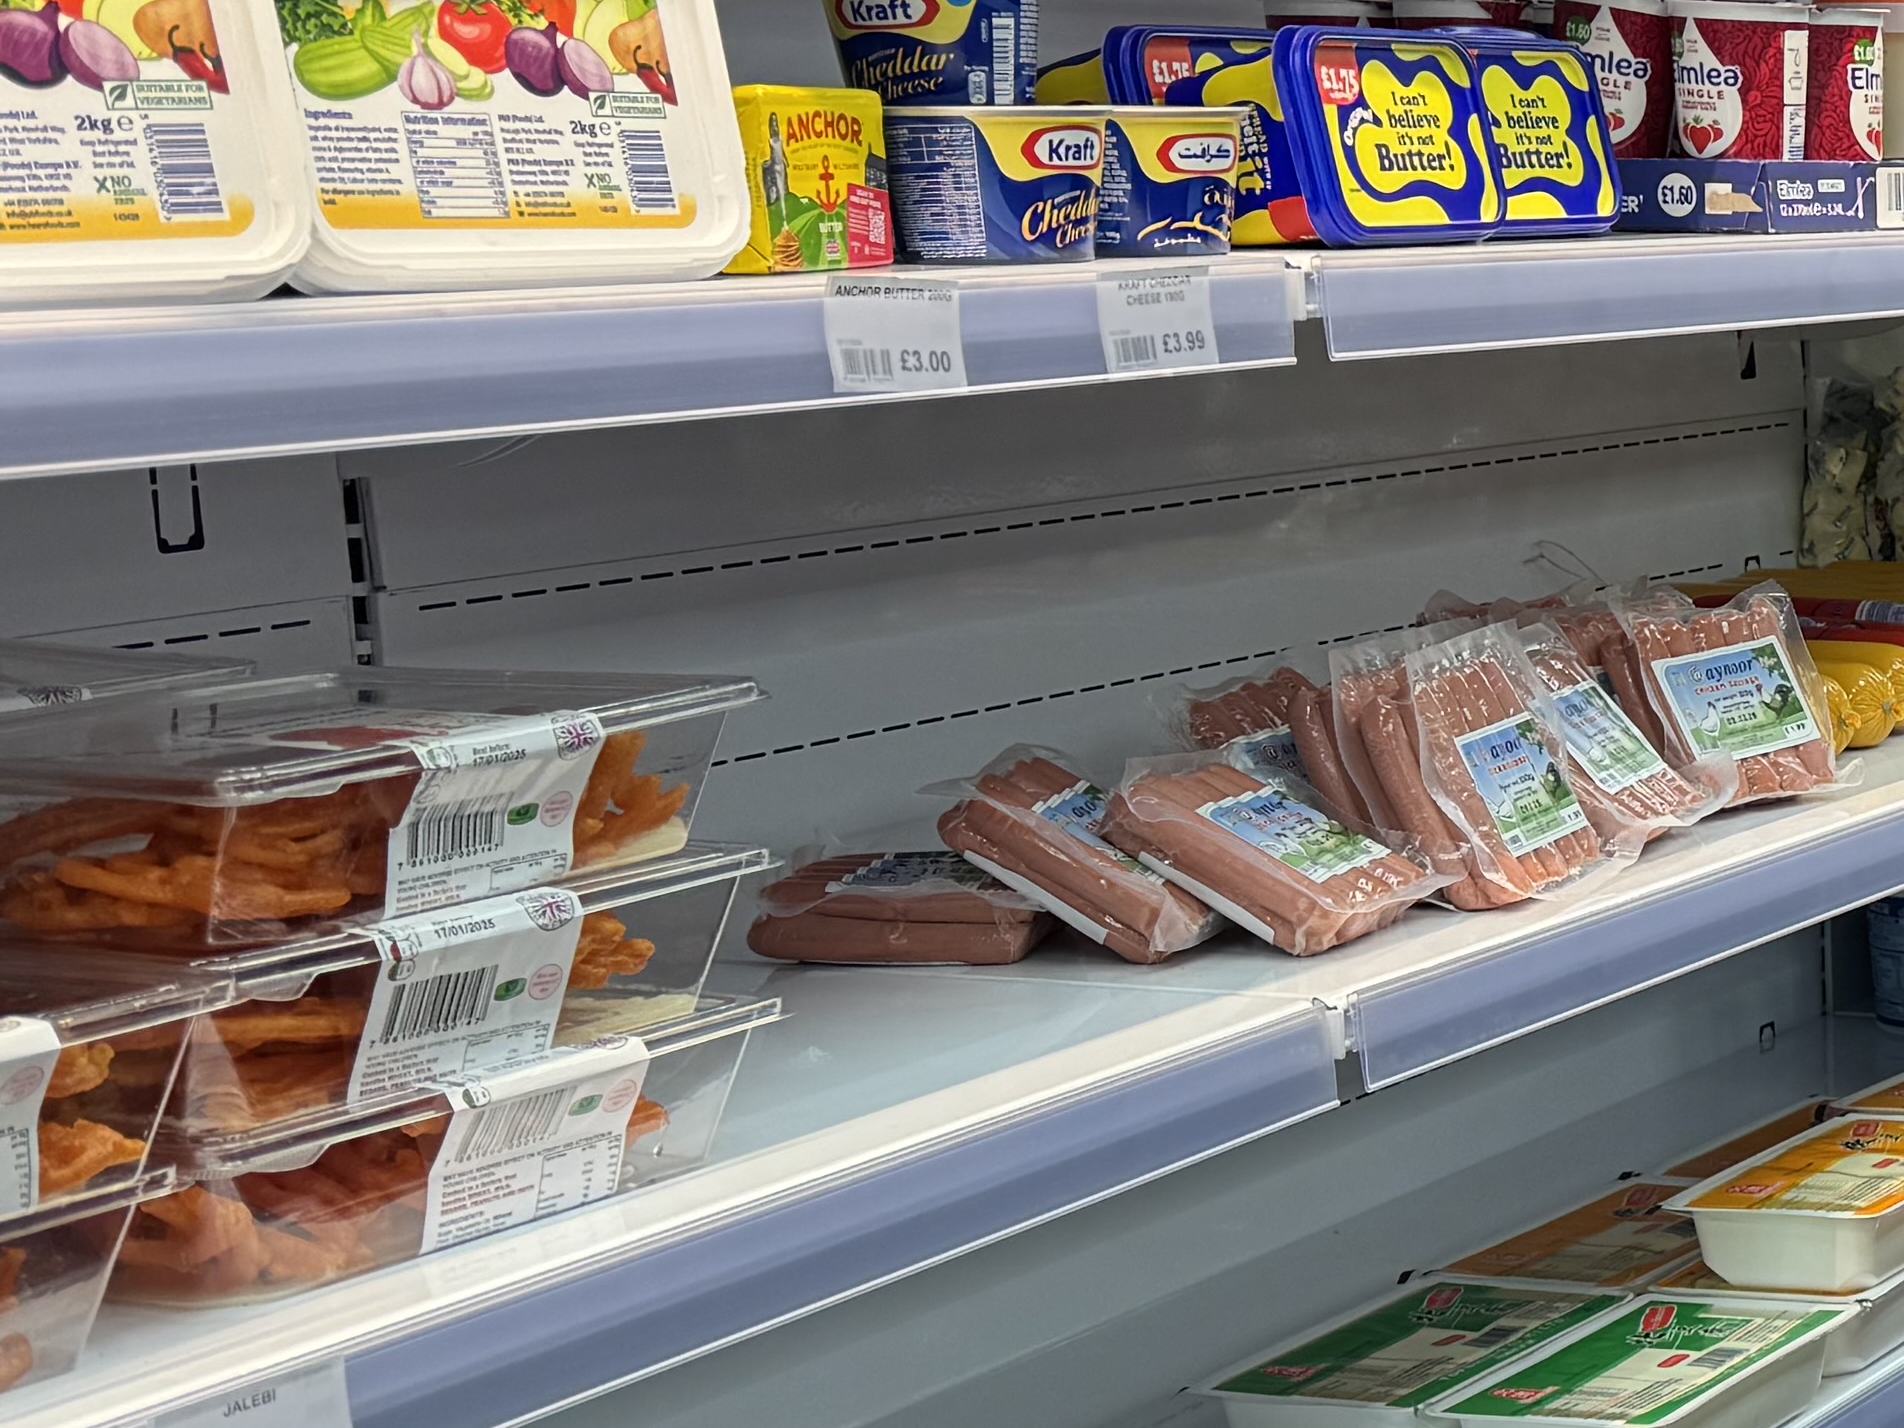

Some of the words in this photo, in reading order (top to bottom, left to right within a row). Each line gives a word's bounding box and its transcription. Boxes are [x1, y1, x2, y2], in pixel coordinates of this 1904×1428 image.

[851, 44, 954, 90] Cheddar
[1321, 65, 1359, 97] £1.75
[138, 96, 208, 106] VEGETARIANS
[1400, 93, 1428, 106] can't
[1519, 94, 1547, 108] can't
[74, 114, 114, 135] 2kg
[570, 120, 596, 138] 2kg
[785, 109, 863, 148] ANCHOR
[1388, 109, 1441, 129] believe
[1505, 110, 1559, 129] believe
[1397, 132, 1413, 146] it's
[1417, 135, 1435, 146] not
[1515, 133, 1531, 146] it's
[1535, 135, 1554, 146] not
[1049, 137, 1095, 162] Kraft
[1376, 141, 1456, 172] Butter!
[111, 175, 131, 188] NO
[598, 174, 612, 185] NO
[1661, 185, 1693, 206] £1.60
[835, 284, 883, 298] ANCHOR
[1162, 330, 1206, 354] £3.99
[900, 349, 952, 373] £3.00
[223, 1389, 277, 1418] JALEBI
